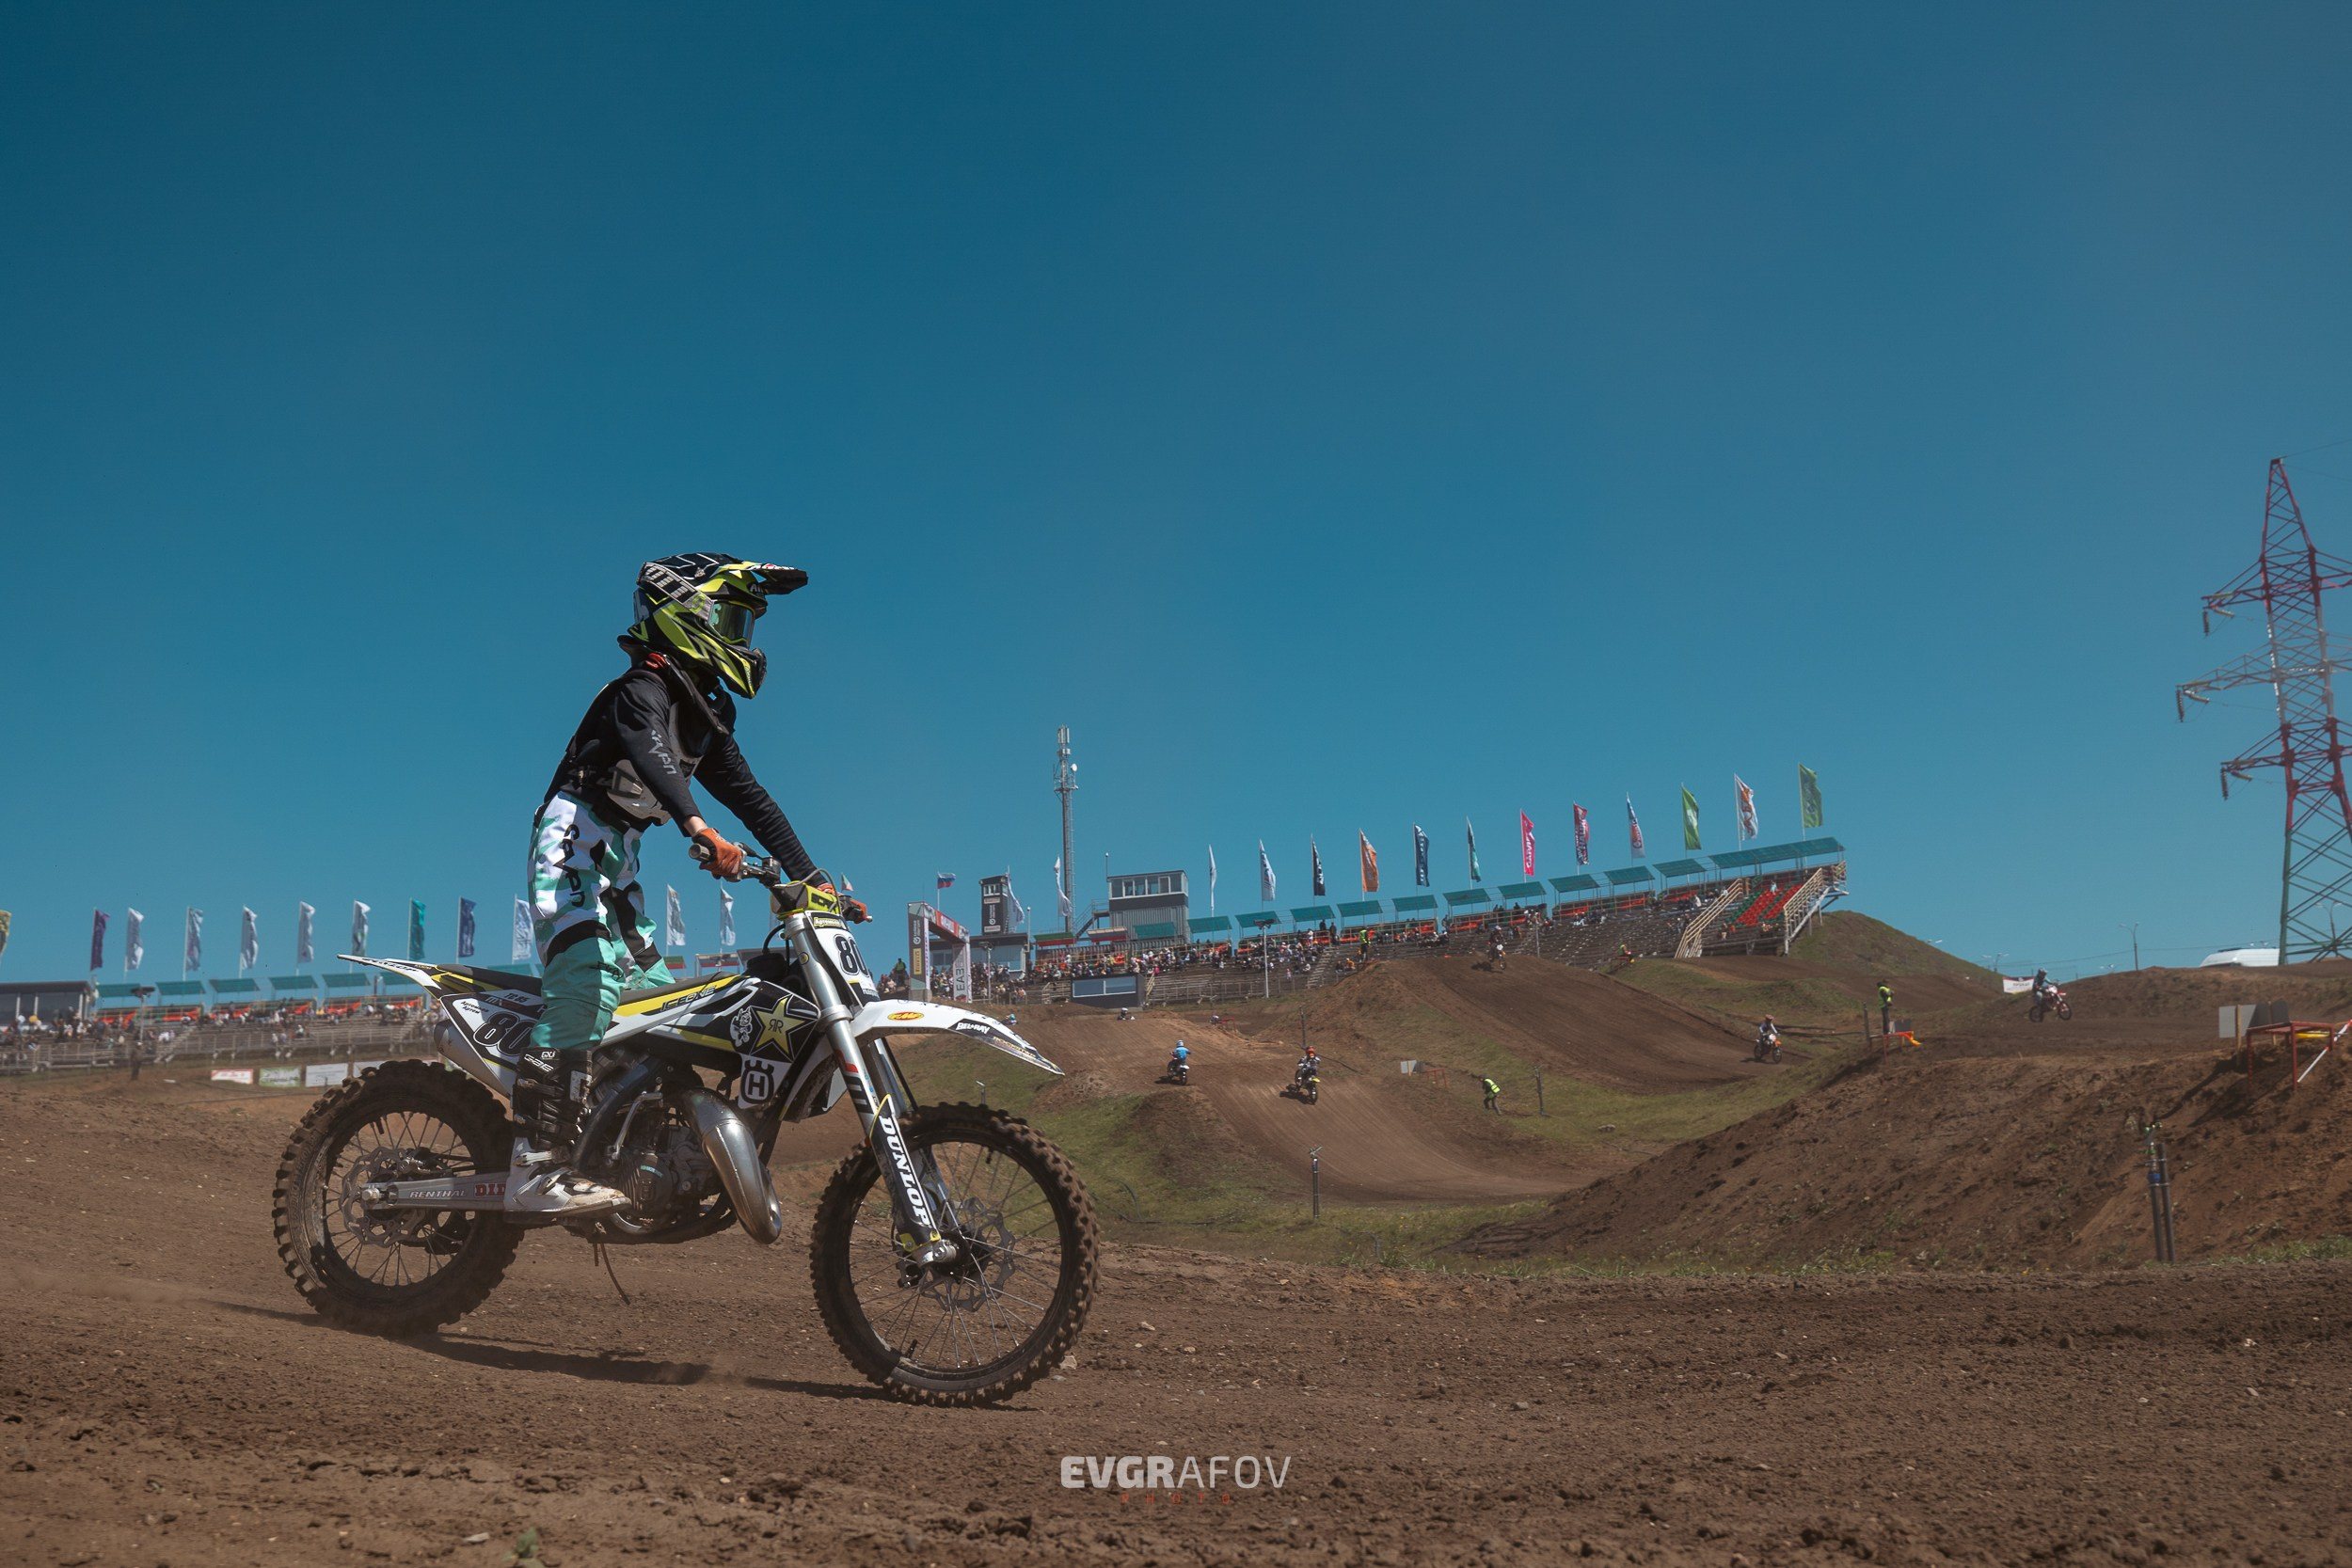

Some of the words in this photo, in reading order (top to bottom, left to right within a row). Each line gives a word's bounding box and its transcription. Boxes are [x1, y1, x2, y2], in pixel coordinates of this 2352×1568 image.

[473, 1011, 538, 1056] 80
[409, 1190, 468, 1198] RENTHAL
[878, 1115, 932, 1228] DUNLOP
